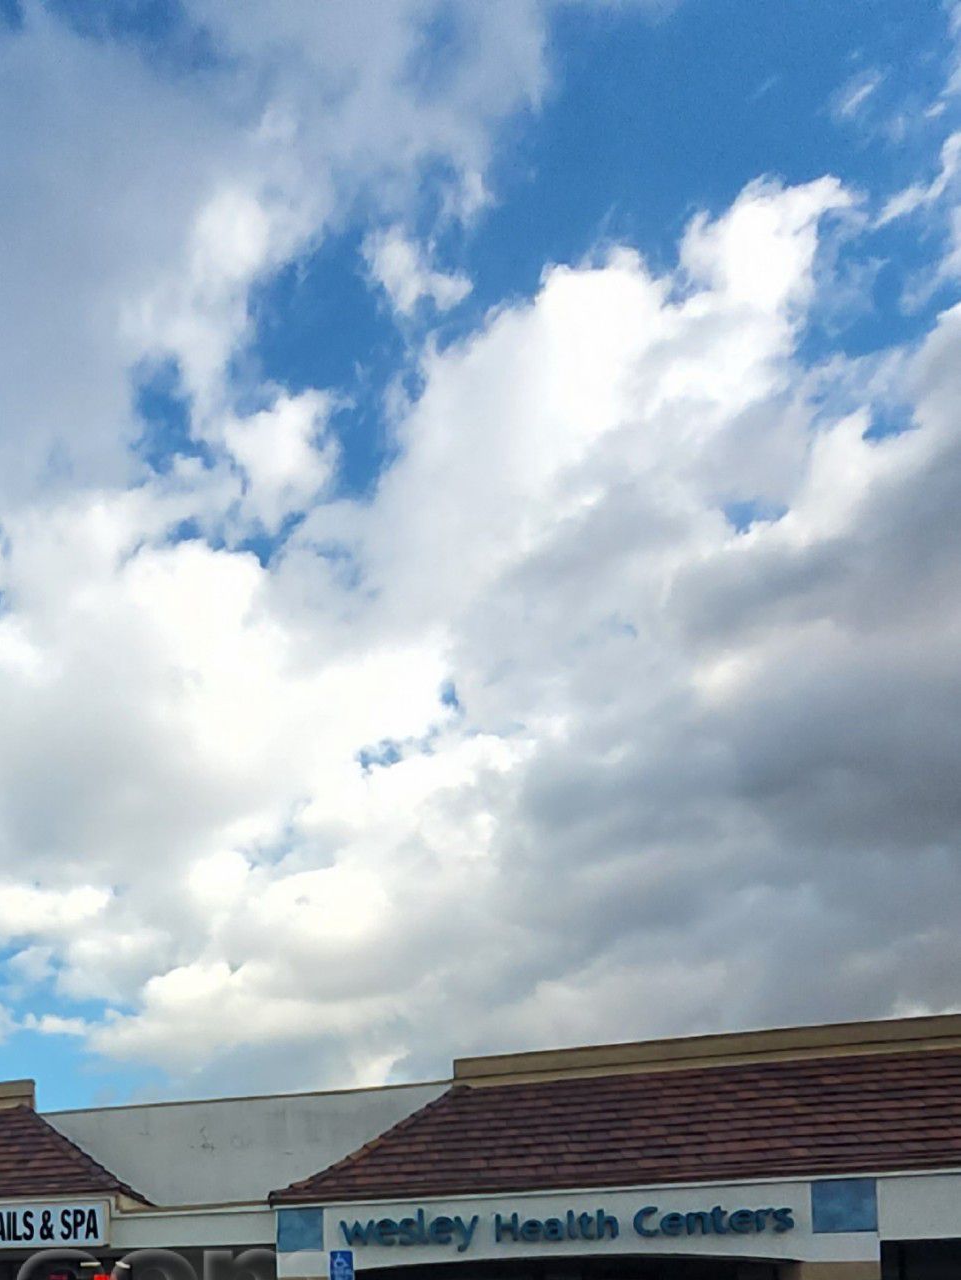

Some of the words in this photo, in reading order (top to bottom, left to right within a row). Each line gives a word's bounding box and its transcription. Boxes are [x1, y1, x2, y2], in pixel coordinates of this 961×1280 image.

[39, 1210, 55, 1240] &
[60, 1208, 99, 1240] SPA
[339, 1208, 479, 1252] wesley
[495, 1208, 619, 1242] Health
[633, 1205, 795, 1238] Centers
